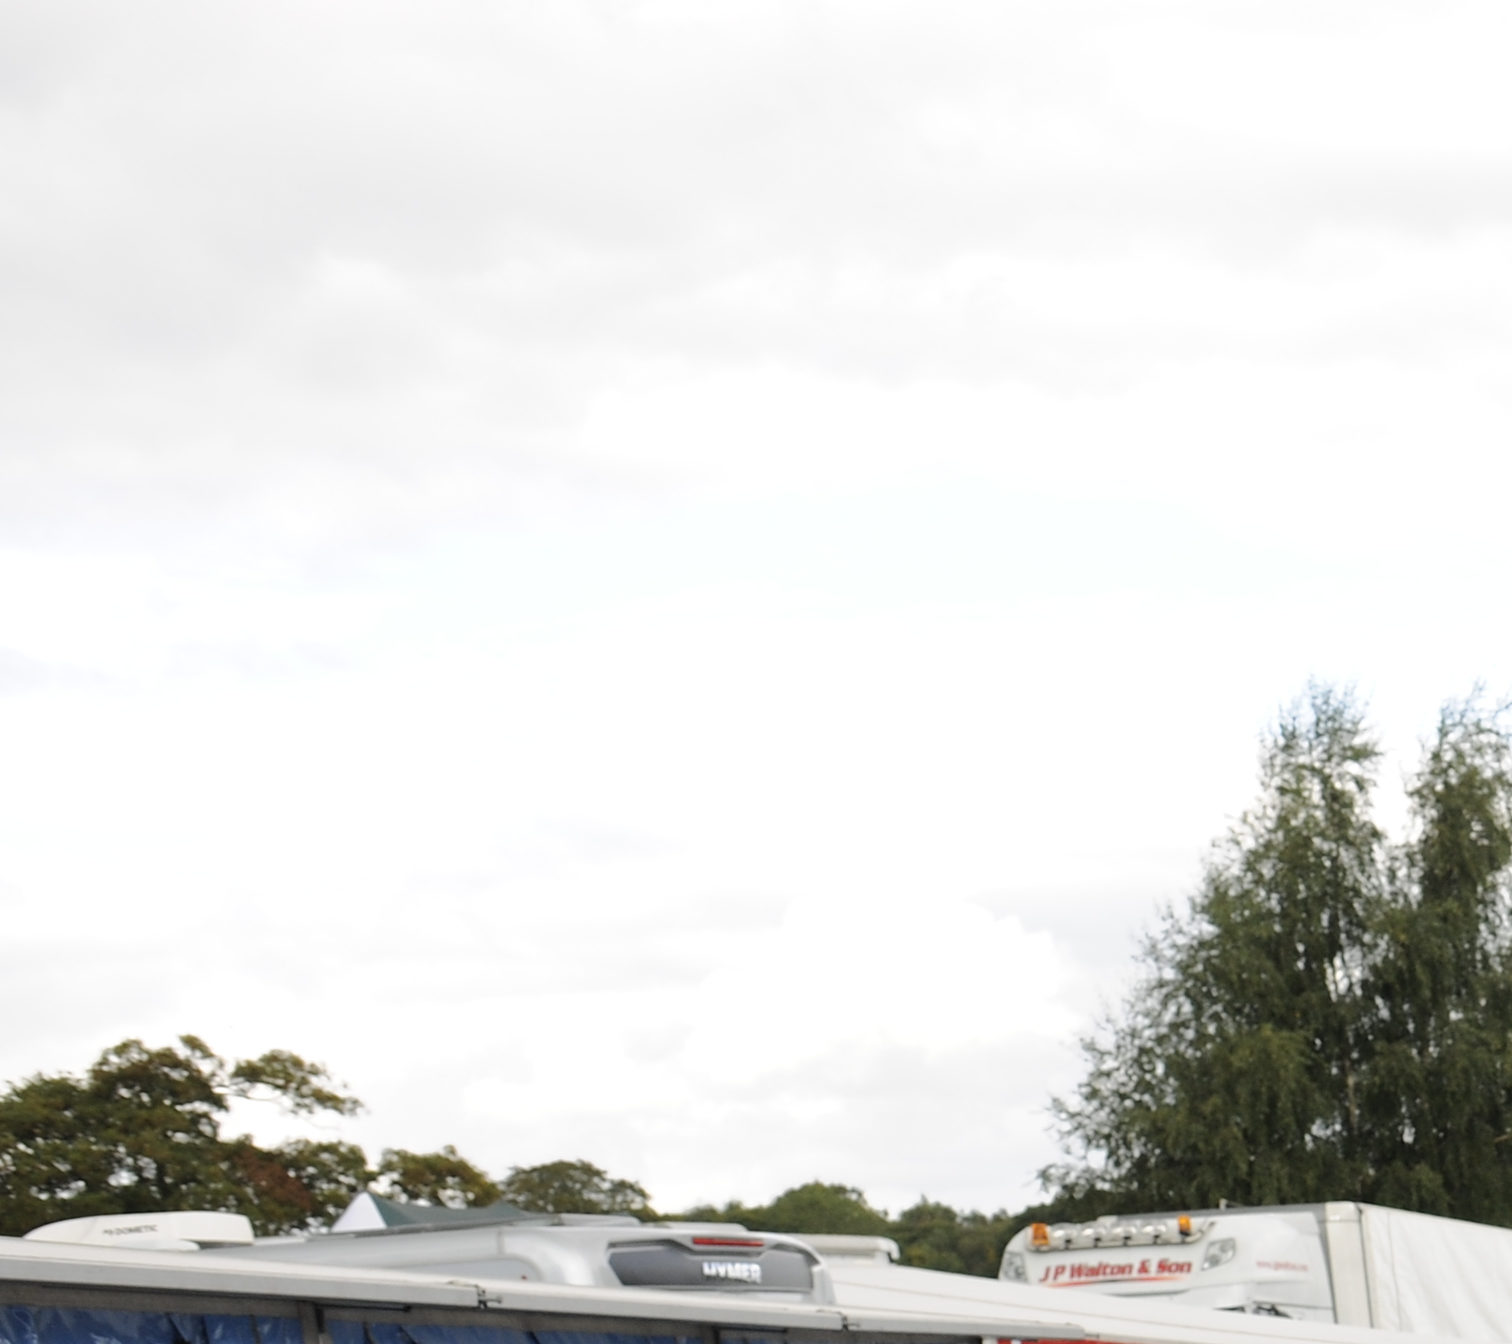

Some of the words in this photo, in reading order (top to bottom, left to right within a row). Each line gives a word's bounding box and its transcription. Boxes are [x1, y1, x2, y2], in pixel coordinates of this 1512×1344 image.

[1040, 1267, 1051, 1283] J
[1053, 1266, 1066, 1279] P
[1068, 1262, 1132, 1278] Walton
[1137, 1259, 1151, 1275] &
[1156, 1259, 1192, 1274] Son
